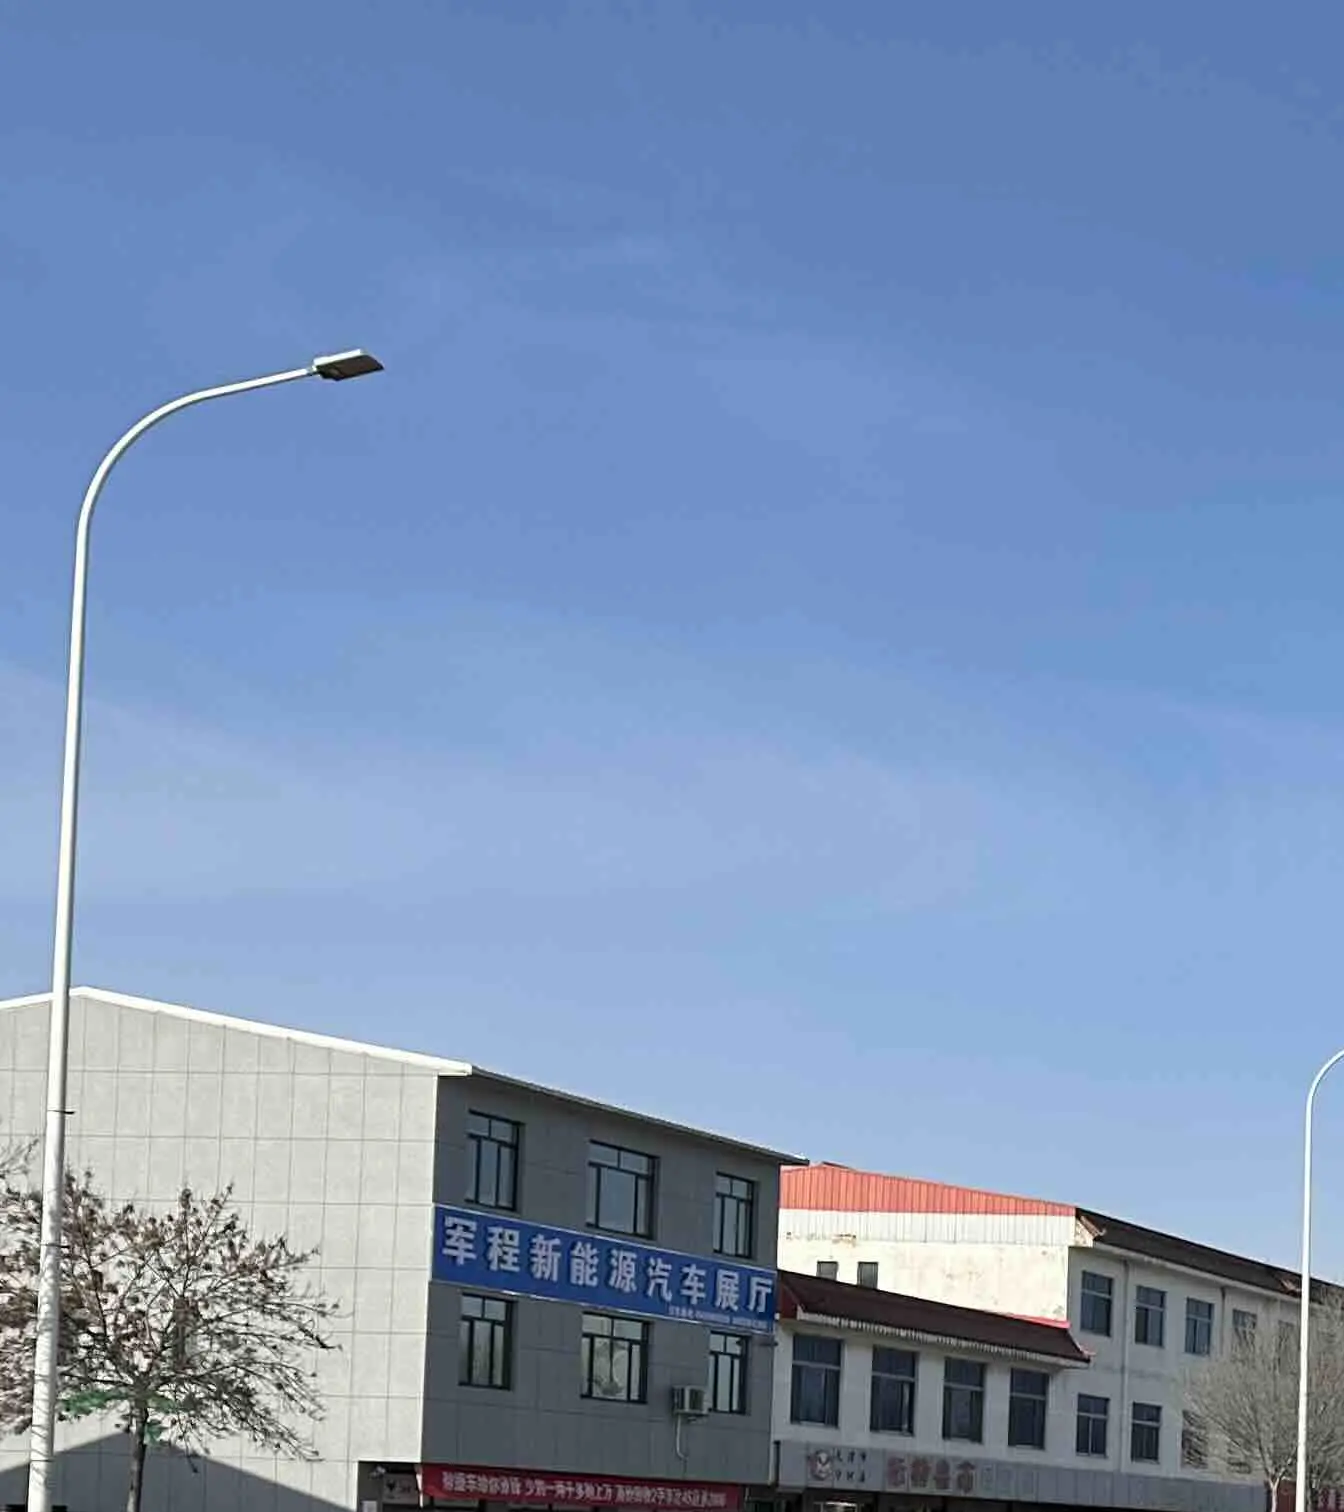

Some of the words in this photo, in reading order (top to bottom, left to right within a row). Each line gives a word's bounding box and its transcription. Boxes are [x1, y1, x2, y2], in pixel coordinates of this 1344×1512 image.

[442, 1215, 774, 1314] 军程新能源汽车展厅
